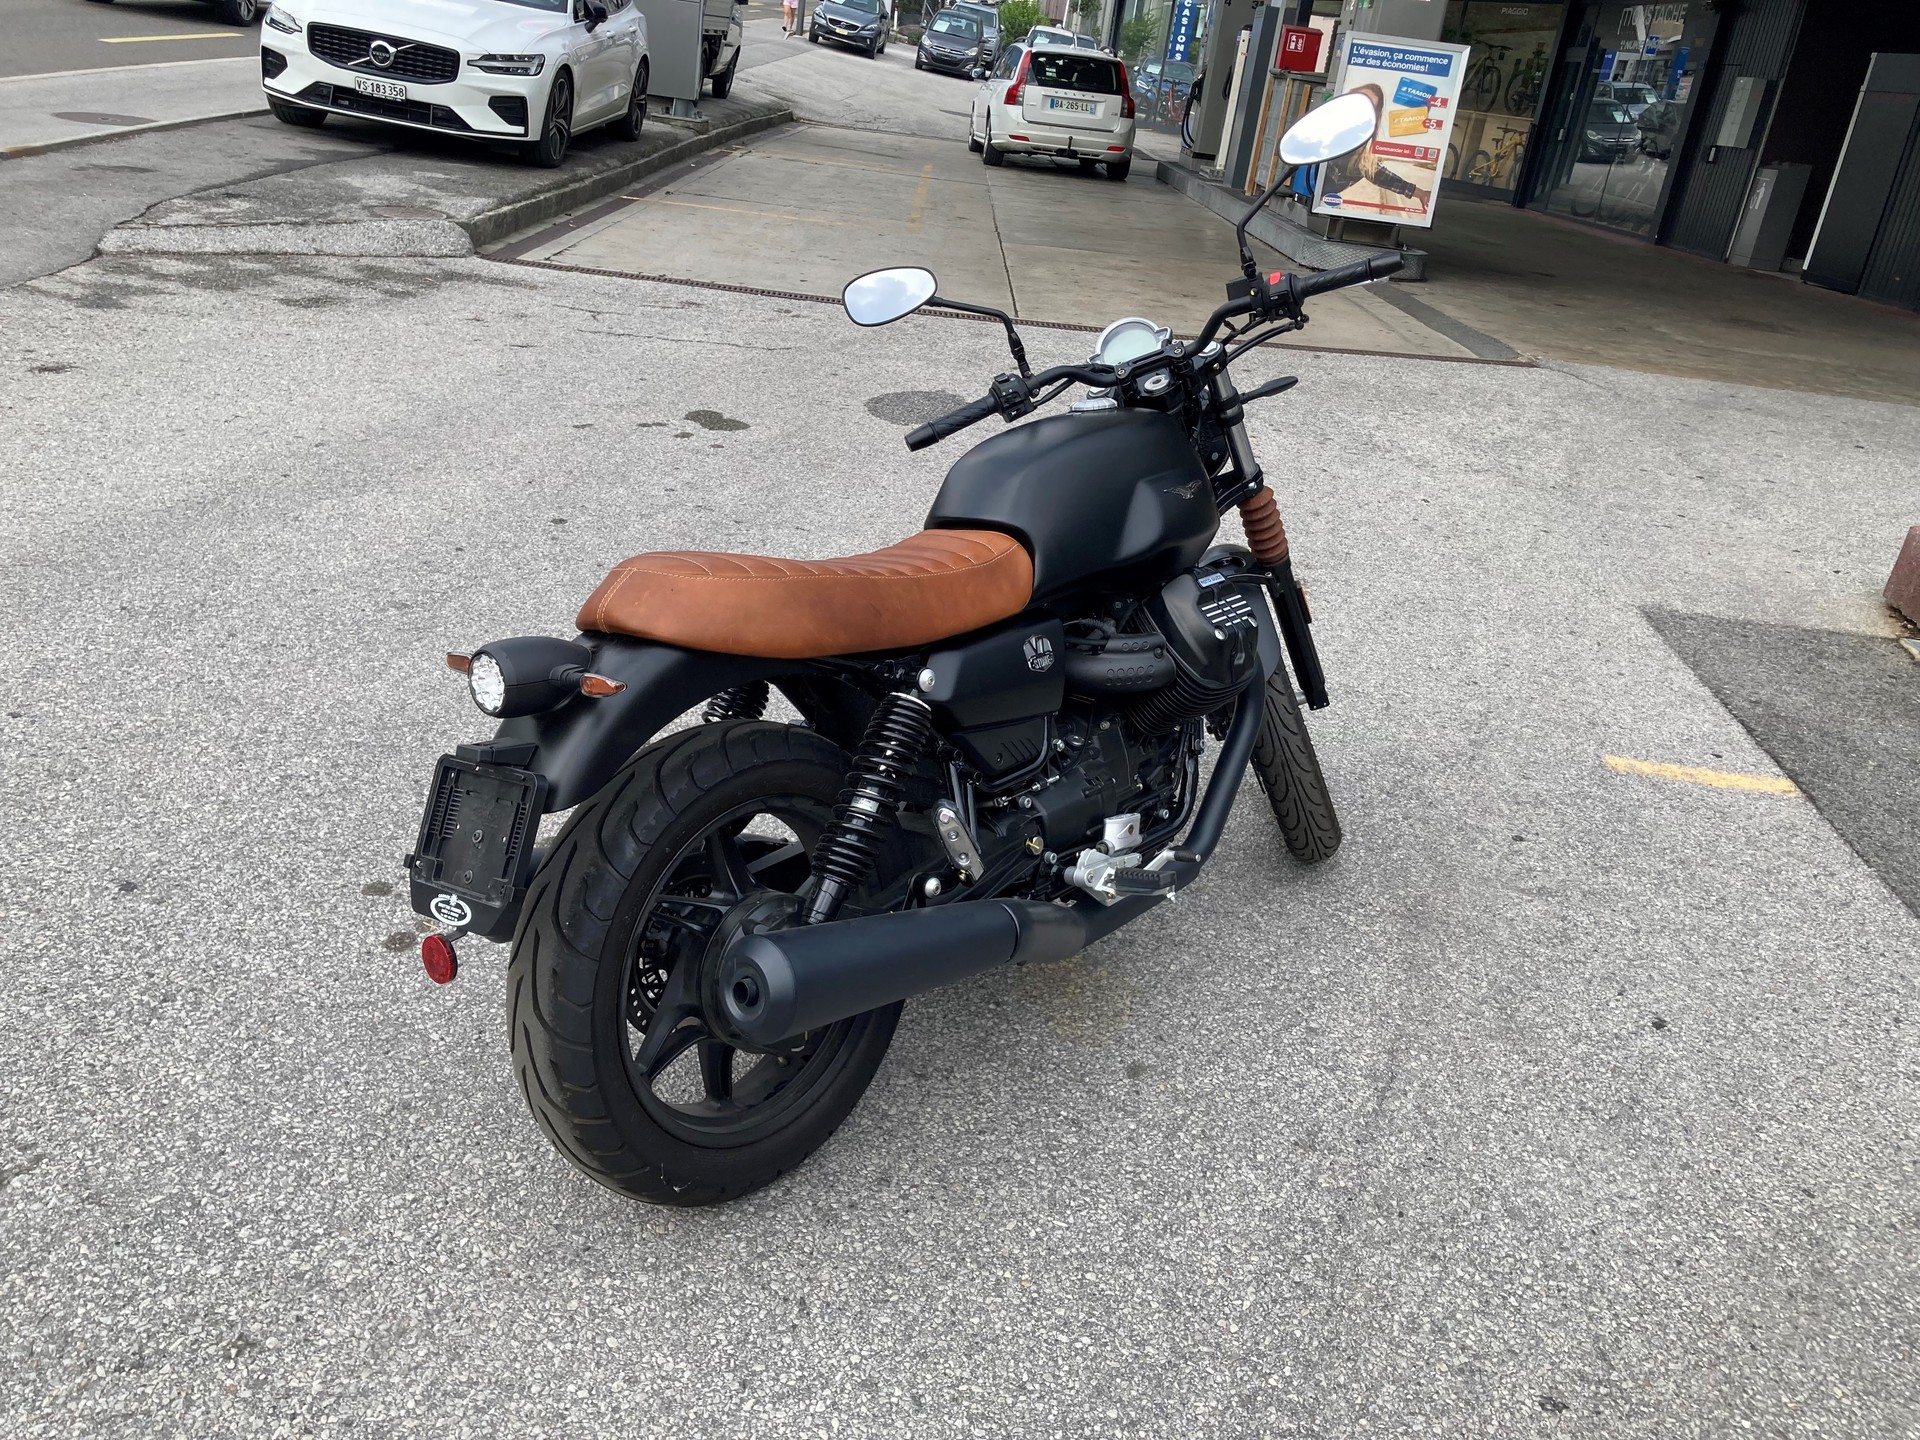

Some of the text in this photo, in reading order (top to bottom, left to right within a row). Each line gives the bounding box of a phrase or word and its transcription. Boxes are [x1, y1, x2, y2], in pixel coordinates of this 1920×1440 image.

[1501, 7, 1529, 15] PIAGGIO
[1353, 46, 1449, 65] L'évasion, ça commence
[1351, 56, 1364, 64] par
[1366, 58, 1380, 66] des
